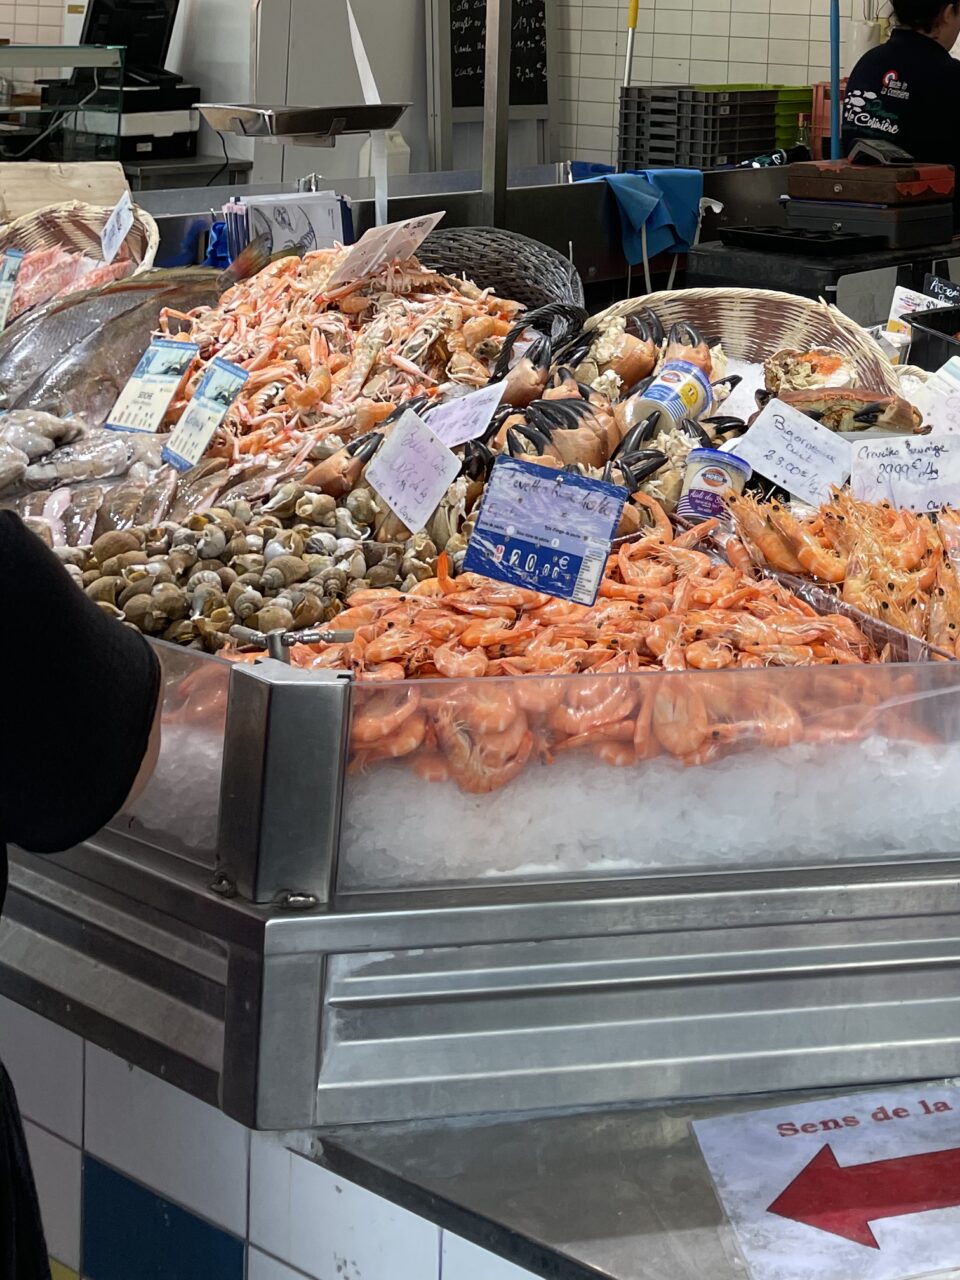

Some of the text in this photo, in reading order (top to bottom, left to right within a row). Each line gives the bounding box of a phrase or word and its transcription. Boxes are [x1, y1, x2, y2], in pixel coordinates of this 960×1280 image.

[776, 1113, 860, 1138] Sens
[871, 1105, 910, 1124] de
[919, 1099, 953, 1117] la
